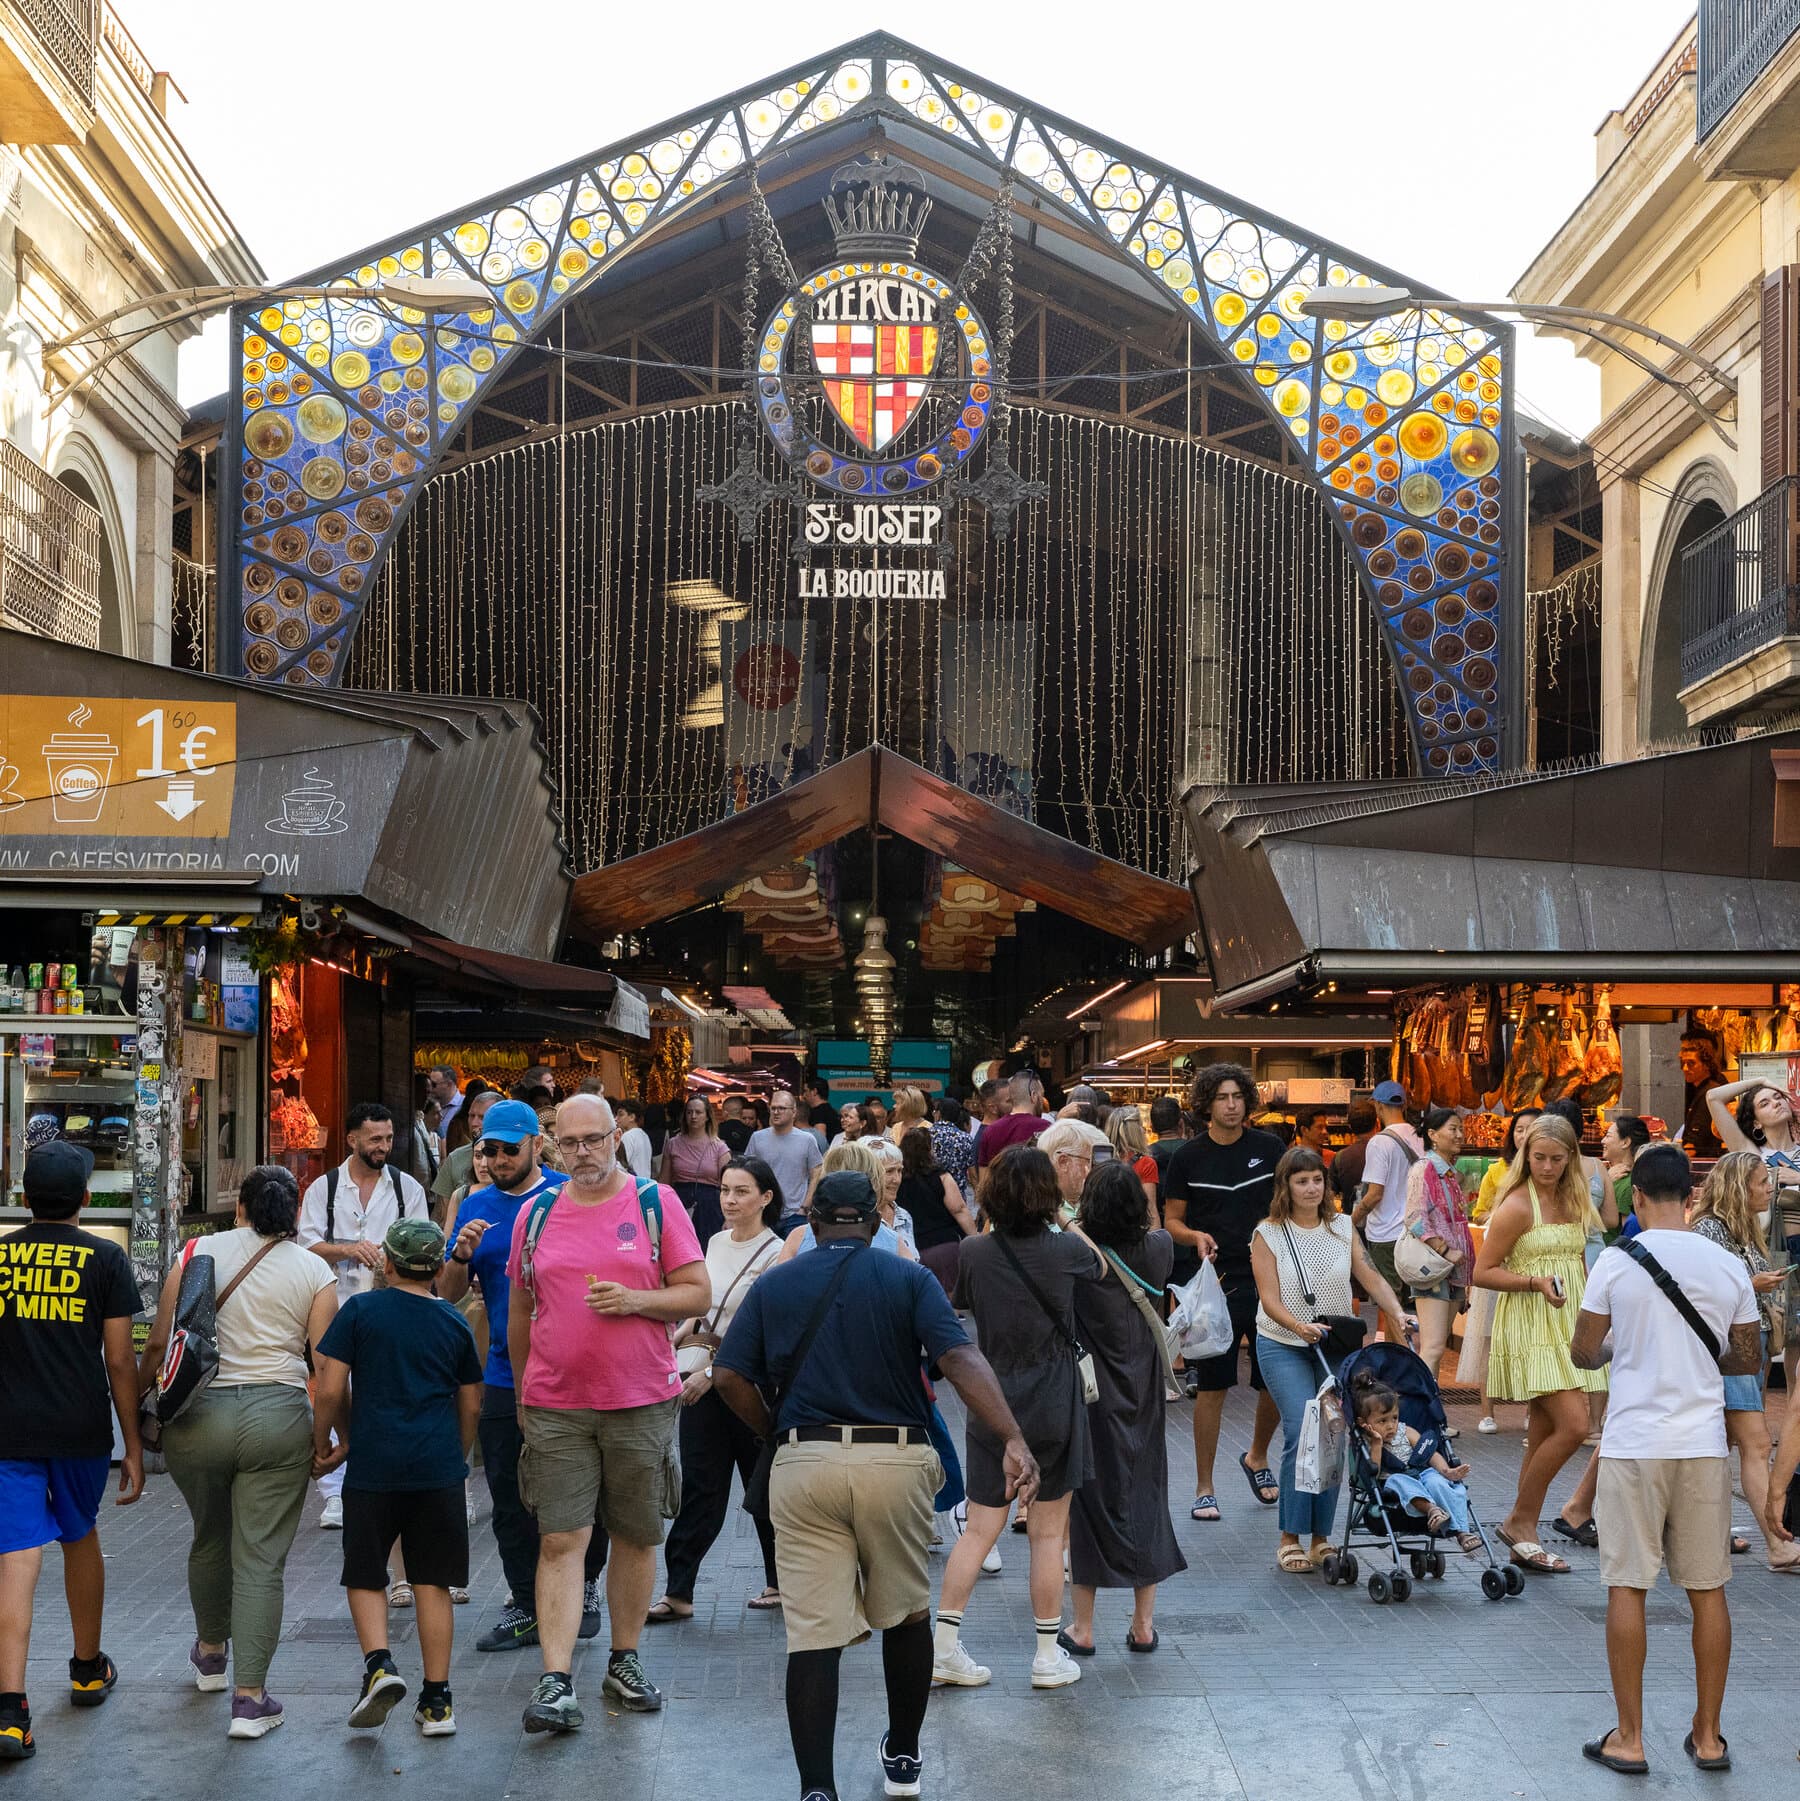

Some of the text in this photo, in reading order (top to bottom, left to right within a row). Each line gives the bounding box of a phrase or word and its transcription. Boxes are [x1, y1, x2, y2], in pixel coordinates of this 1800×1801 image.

[817, 278, 937, 322] MERCAT
[836, 504, 942, 545] JOSEP
[798, 568, 947, 599] LA BOQUERIA
[62, 777, 97, 789] Coffee
[244, 853, 300, 876] COM
[0, 1266, 81, 1294] CHILD
